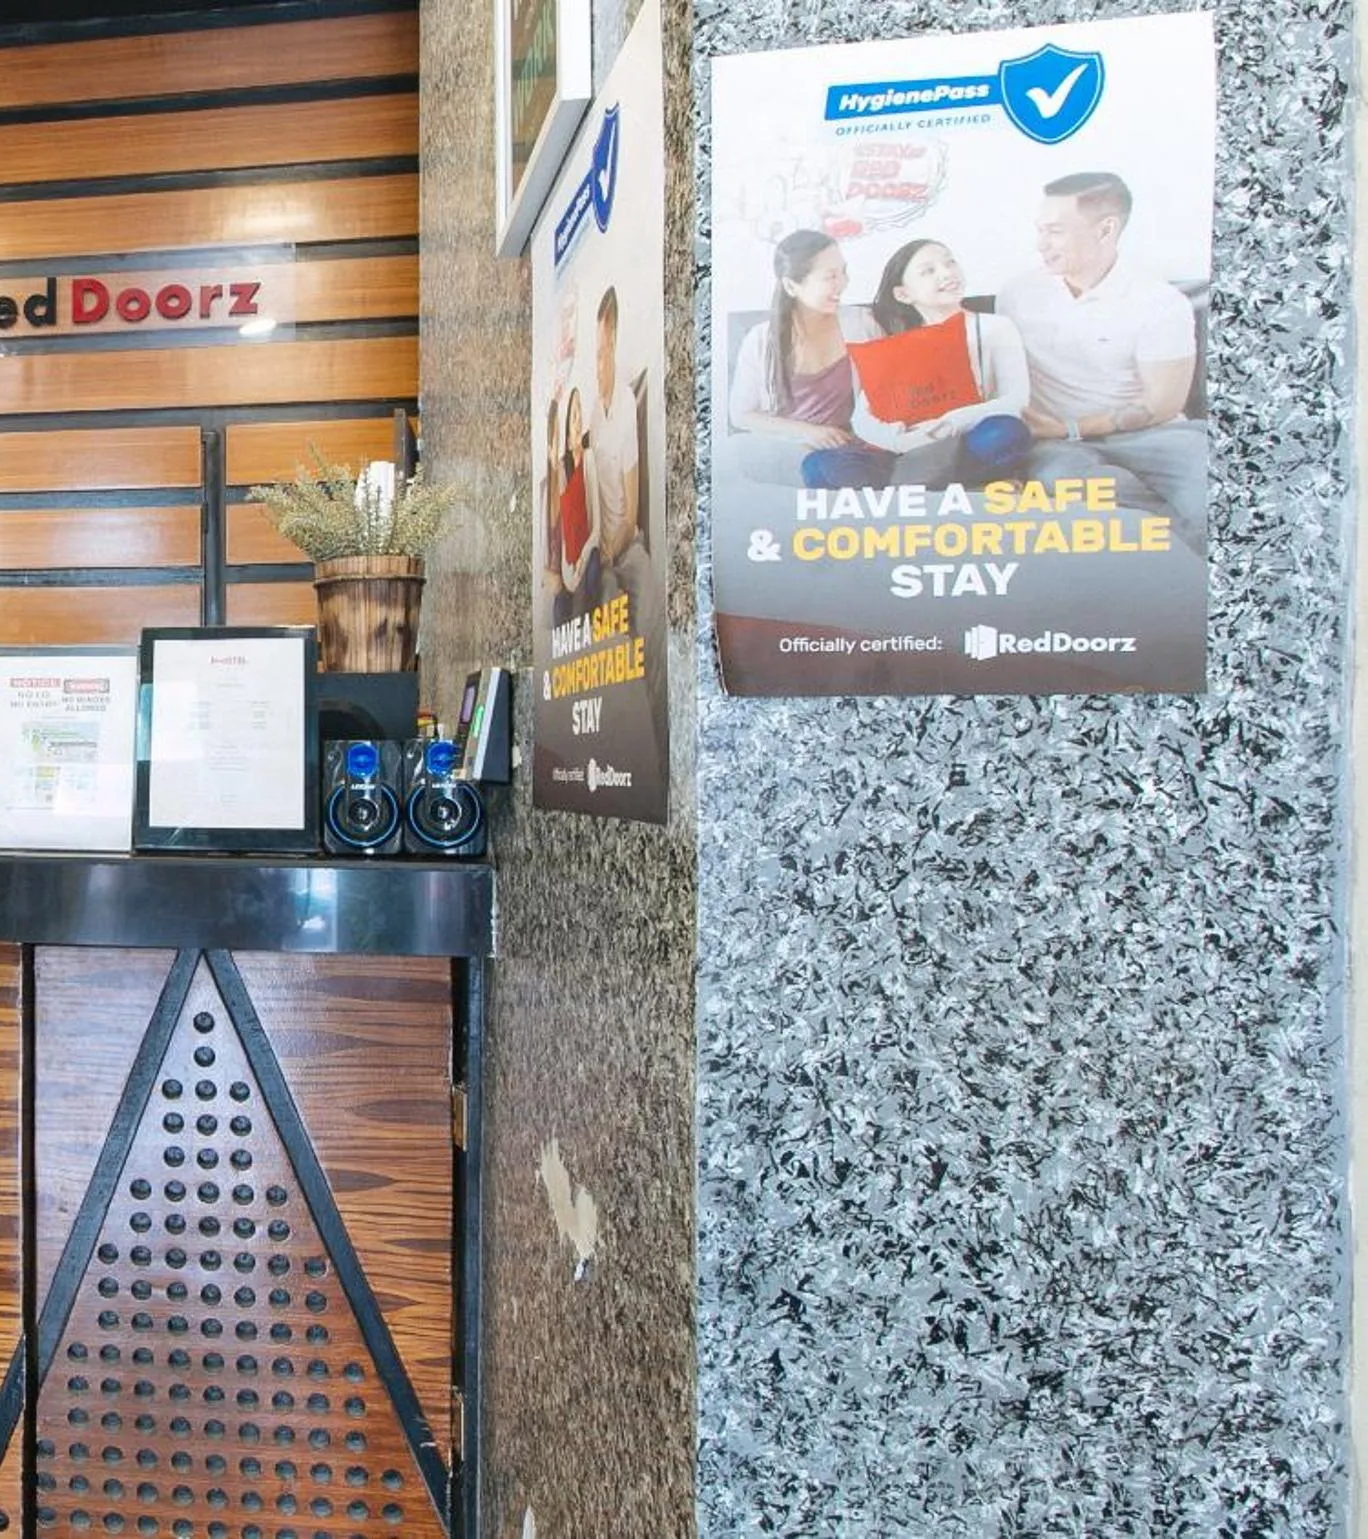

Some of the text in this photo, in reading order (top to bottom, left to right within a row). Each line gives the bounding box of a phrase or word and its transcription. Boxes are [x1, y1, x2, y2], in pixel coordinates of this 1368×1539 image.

[838, 84, 990, 112] HygienePass
[835, 114, 991, 136] OFFICIALLY CERTIFIED
[796, 477, 1117, 521] HAVE A SAFE
[747, 517, 1171, 563] & COMFORTABLE
[890, 562, 1020, 598] STAY
[552, 593, 629, 660] HAVE A SAFE
[779, 631, 1136, 656] Officially certified: RedDoorz
[543, 637, 645, 700] & COMFORTABLE
[572, 696, 603, 736] STAY
